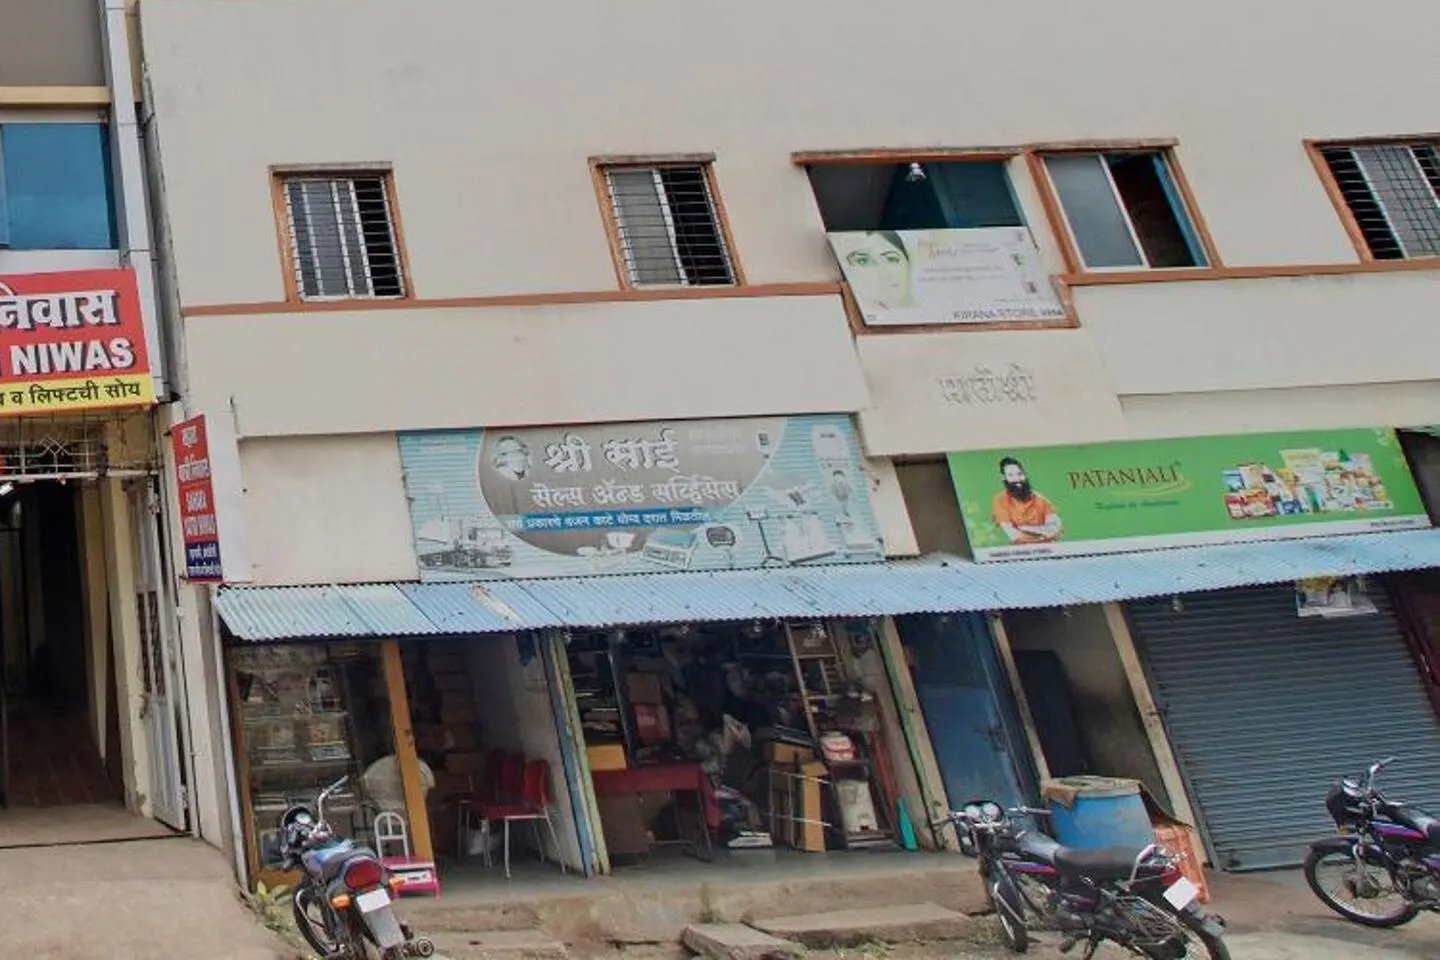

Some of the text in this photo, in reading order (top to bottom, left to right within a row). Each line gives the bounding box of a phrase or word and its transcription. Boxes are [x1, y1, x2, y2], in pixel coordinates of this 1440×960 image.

[10, 337, 134, 376] NIWAS
[11, 390, 24, 405] व
[104, 377, 141, 398] सोय
[544, 431, 592, 473] श्री
[601, 427, 680, 473] साई
[1067, 465, 1178, 489] PATANJALI
[529, 481, 585, 508] सेल्स
